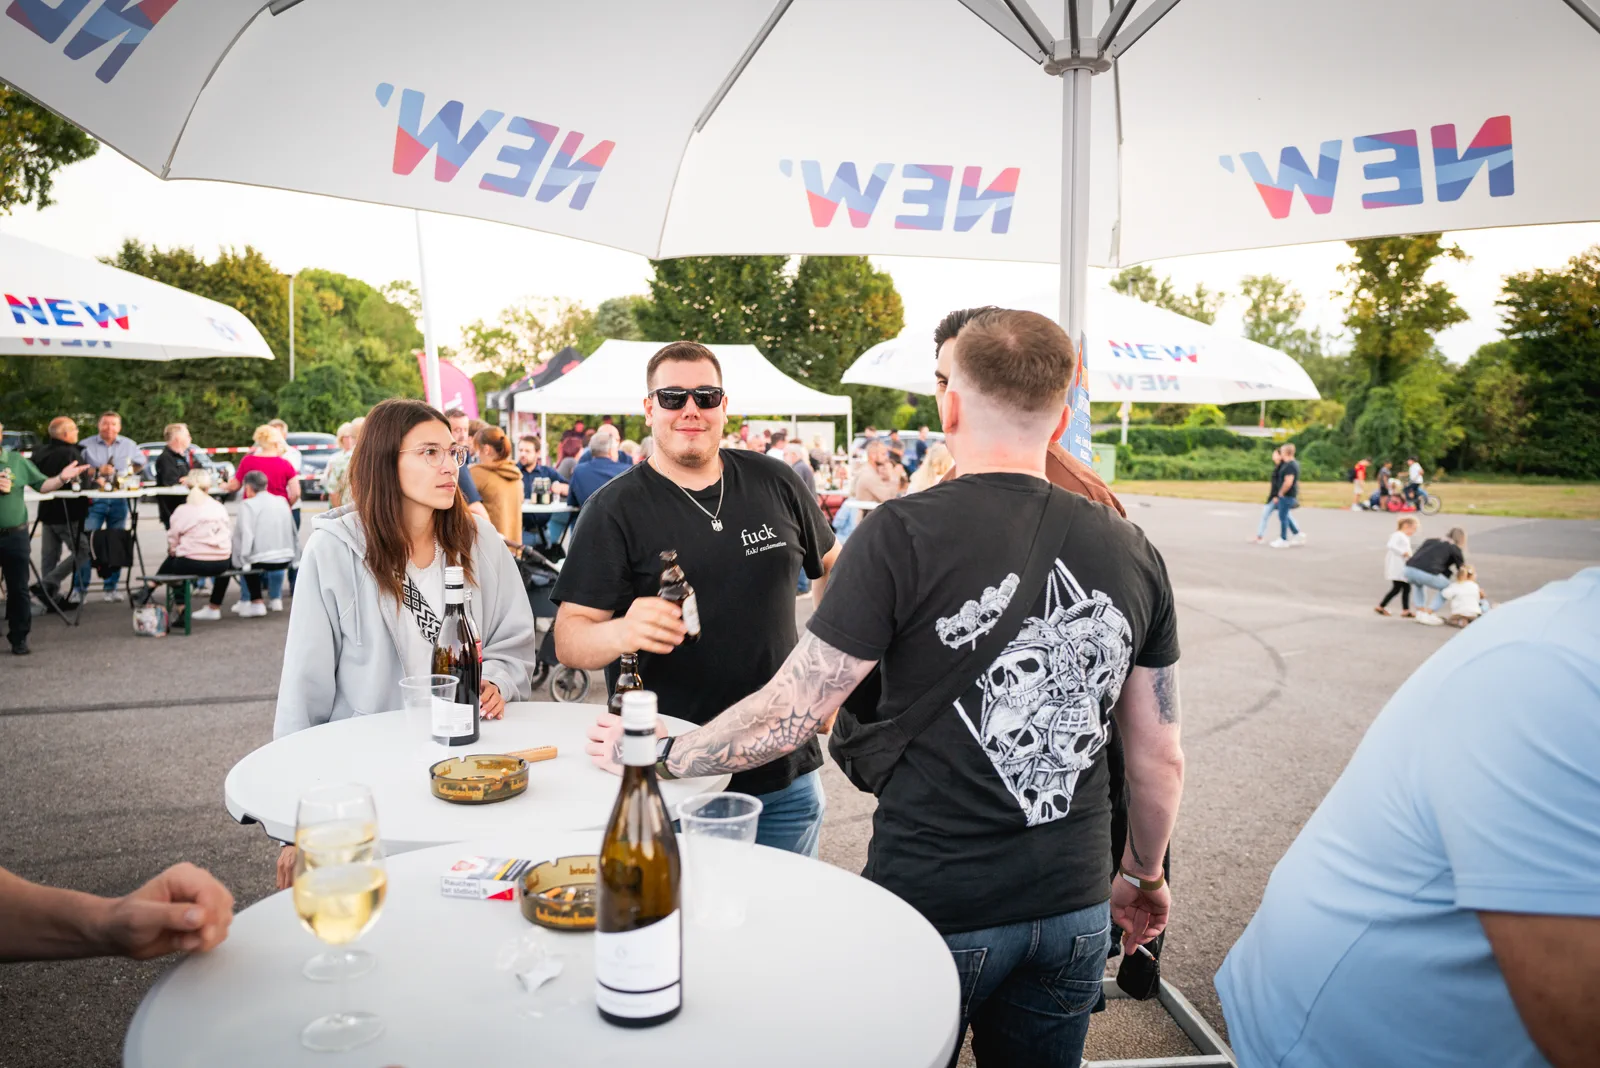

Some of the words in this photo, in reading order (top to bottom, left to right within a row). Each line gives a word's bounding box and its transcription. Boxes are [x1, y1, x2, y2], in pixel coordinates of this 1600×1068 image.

[4, 293, 130, 331] NEW
[1108, 340, 1198, 363] NEW
[740, 523, 777, 546] fuck
